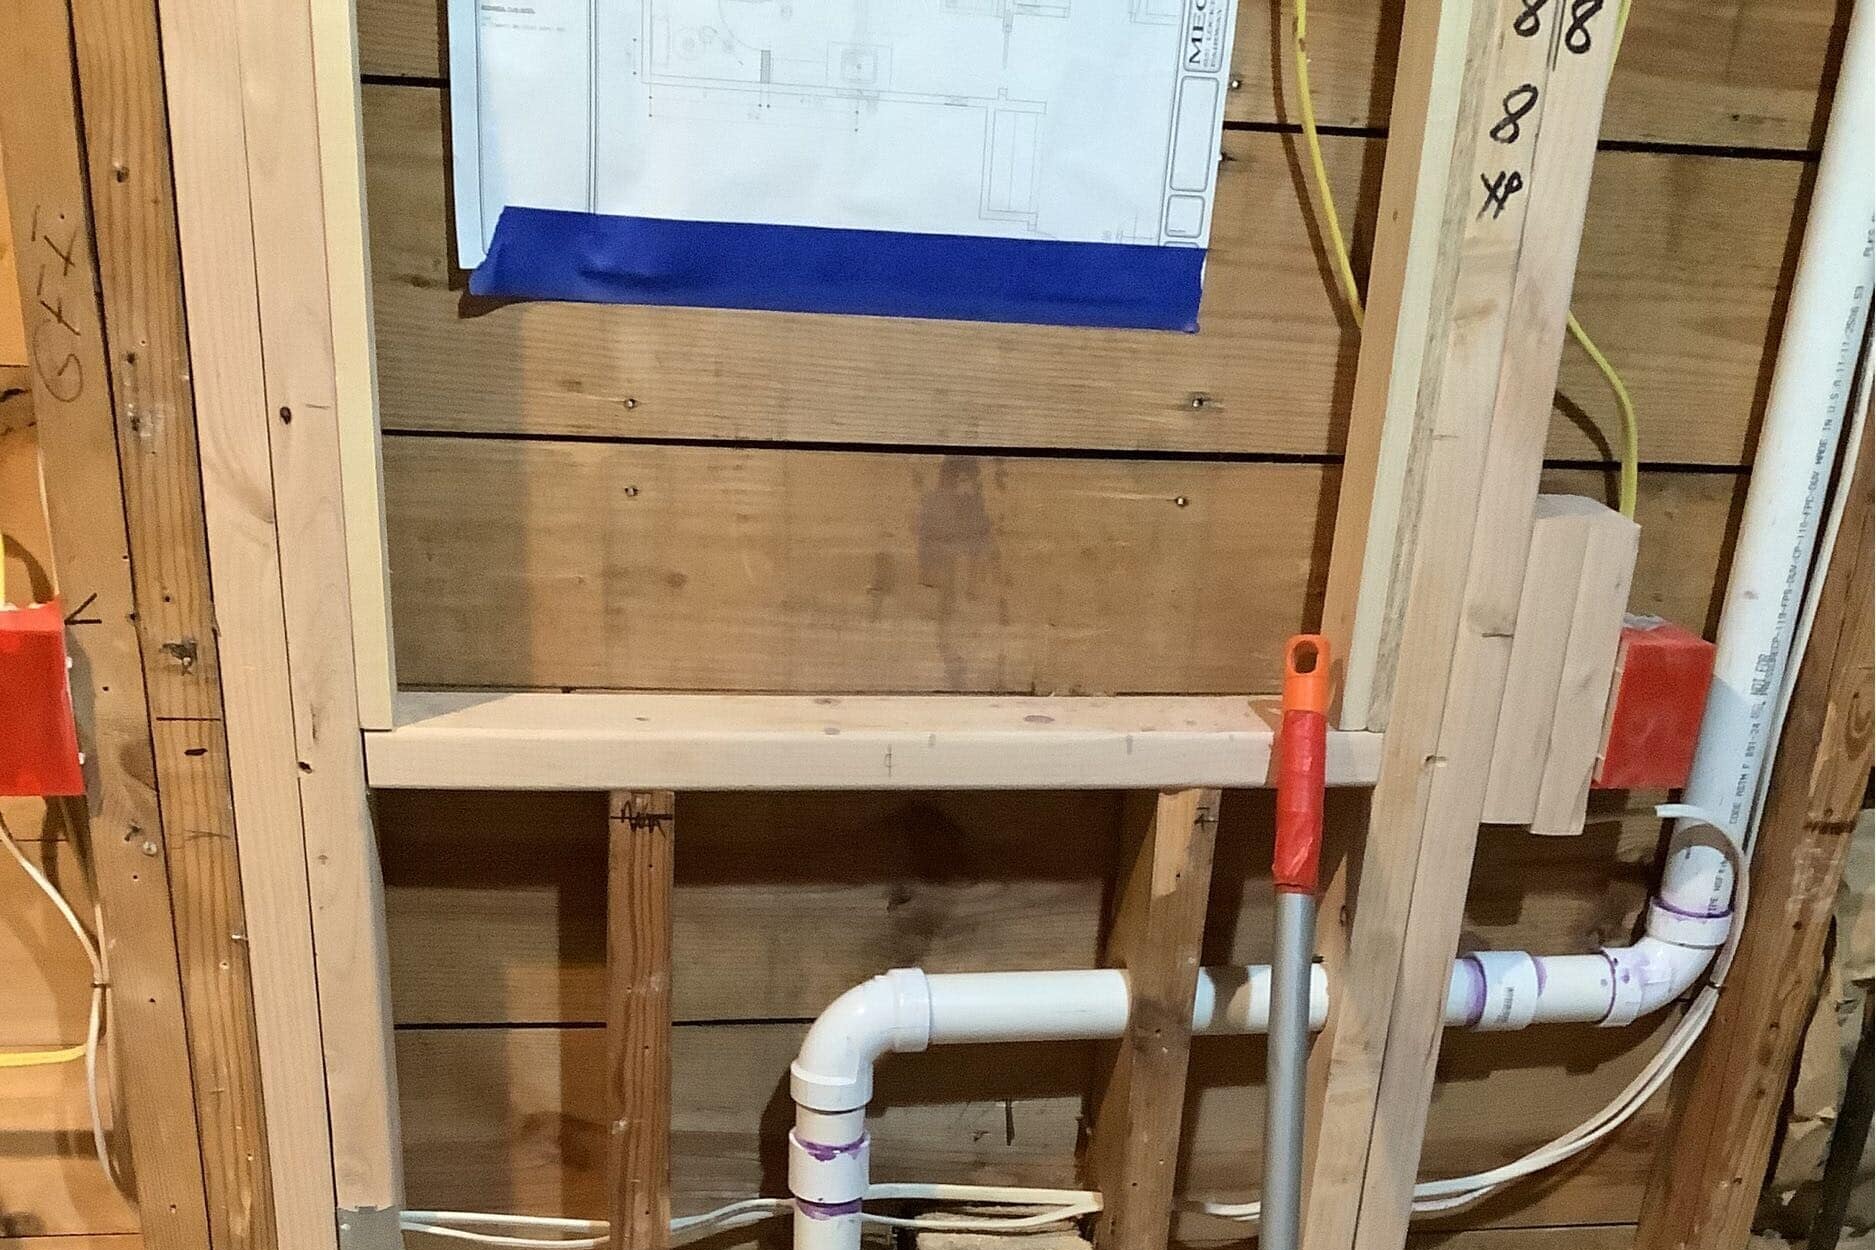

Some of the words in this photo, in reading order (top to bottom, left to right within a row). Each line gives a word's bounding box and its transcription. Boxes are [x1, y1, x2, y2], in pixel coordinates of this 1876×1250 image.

[1565, 0, 1603, 54] 8
[1489, 83, 1539, 144] 8
[1814, 437, 1827, 465] MADE
[1822, 418, 1832, 431] IN
